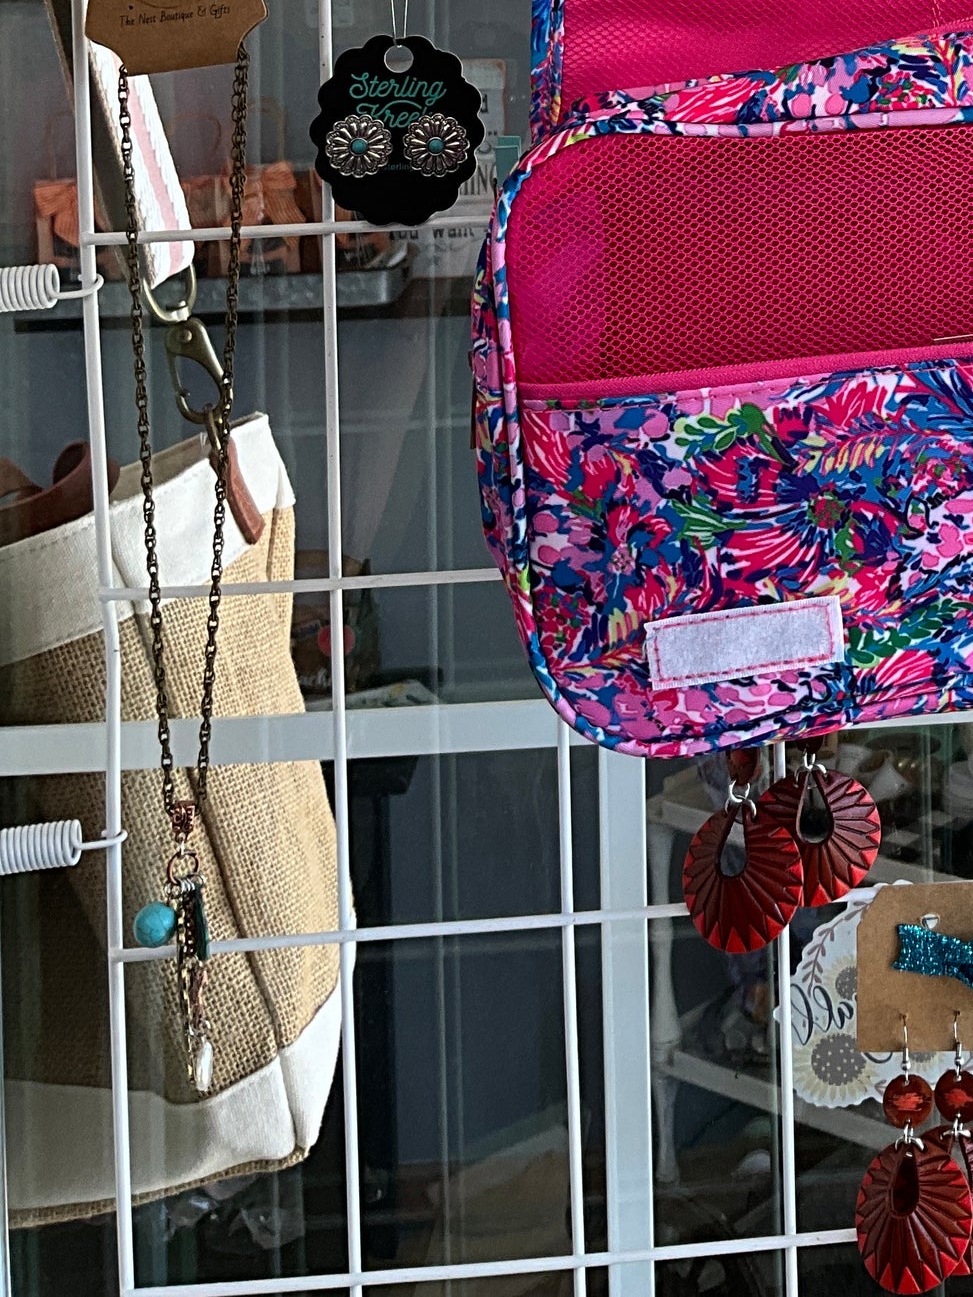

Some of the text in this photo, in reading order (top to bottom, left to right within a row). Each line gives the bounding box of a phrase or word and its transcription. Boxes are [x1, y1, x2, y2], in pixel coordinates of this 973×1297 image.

[120, 4, 231, 27] The Nest Boutique & Gifts
[349, 72, 447, 106] Sterling
